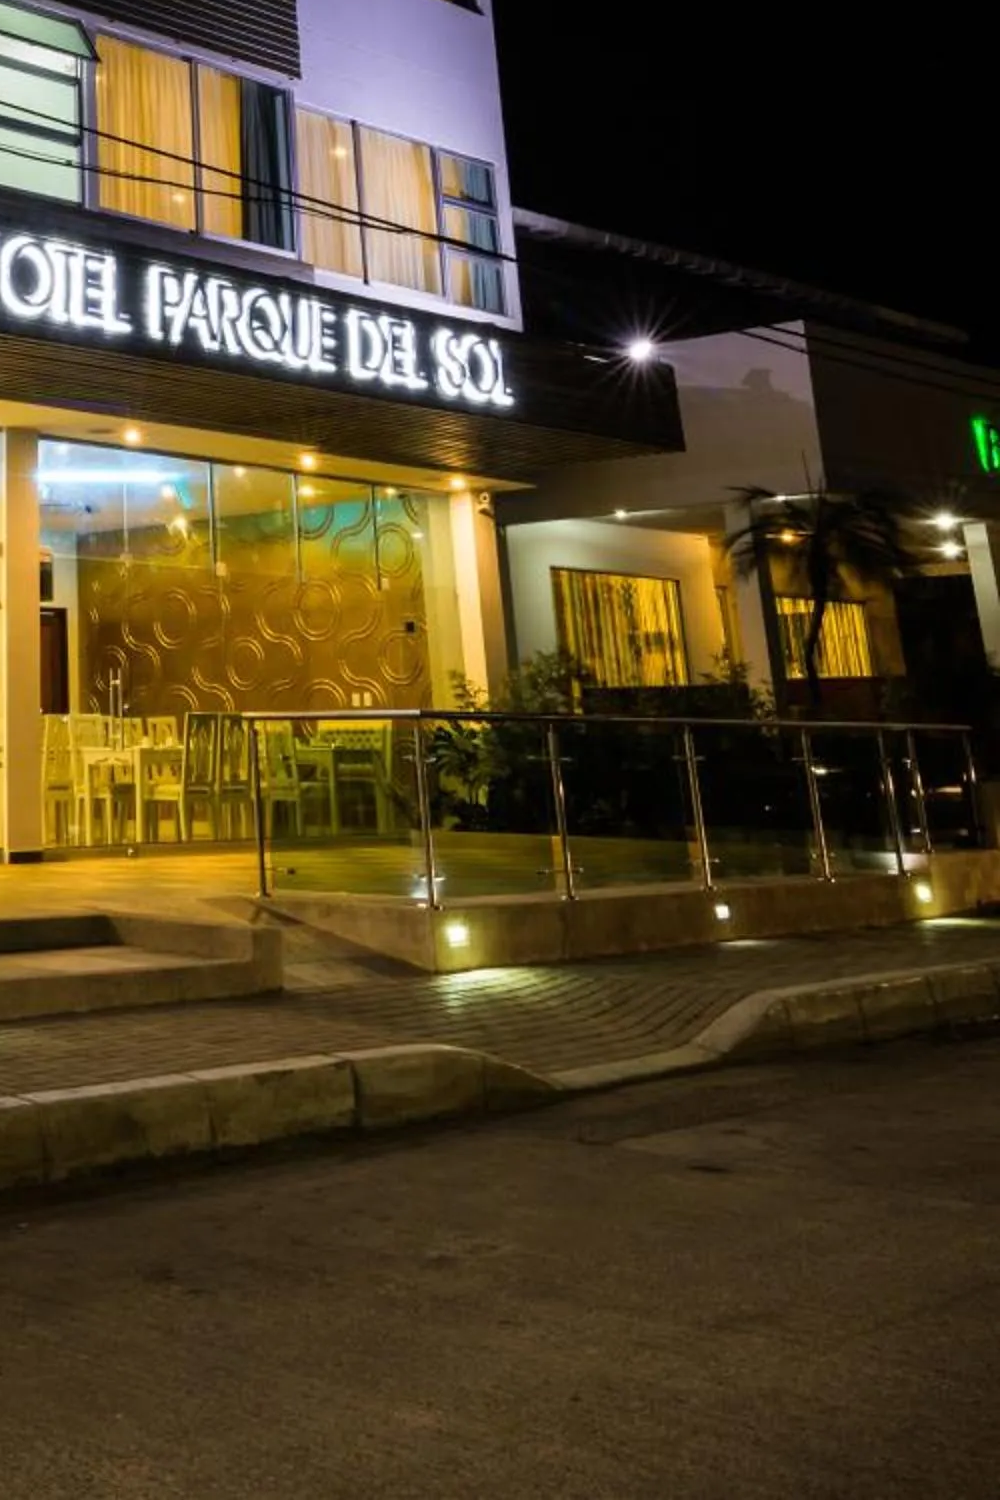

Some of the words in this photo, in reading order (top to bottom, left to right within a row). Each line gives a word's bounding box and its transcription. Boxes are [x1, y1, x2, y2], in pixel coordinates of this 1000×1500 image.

[145, 261, 336, 373] PARQUE
[343, 305, 429, 390] DEL
[432, 327, 515, 407] SOL
